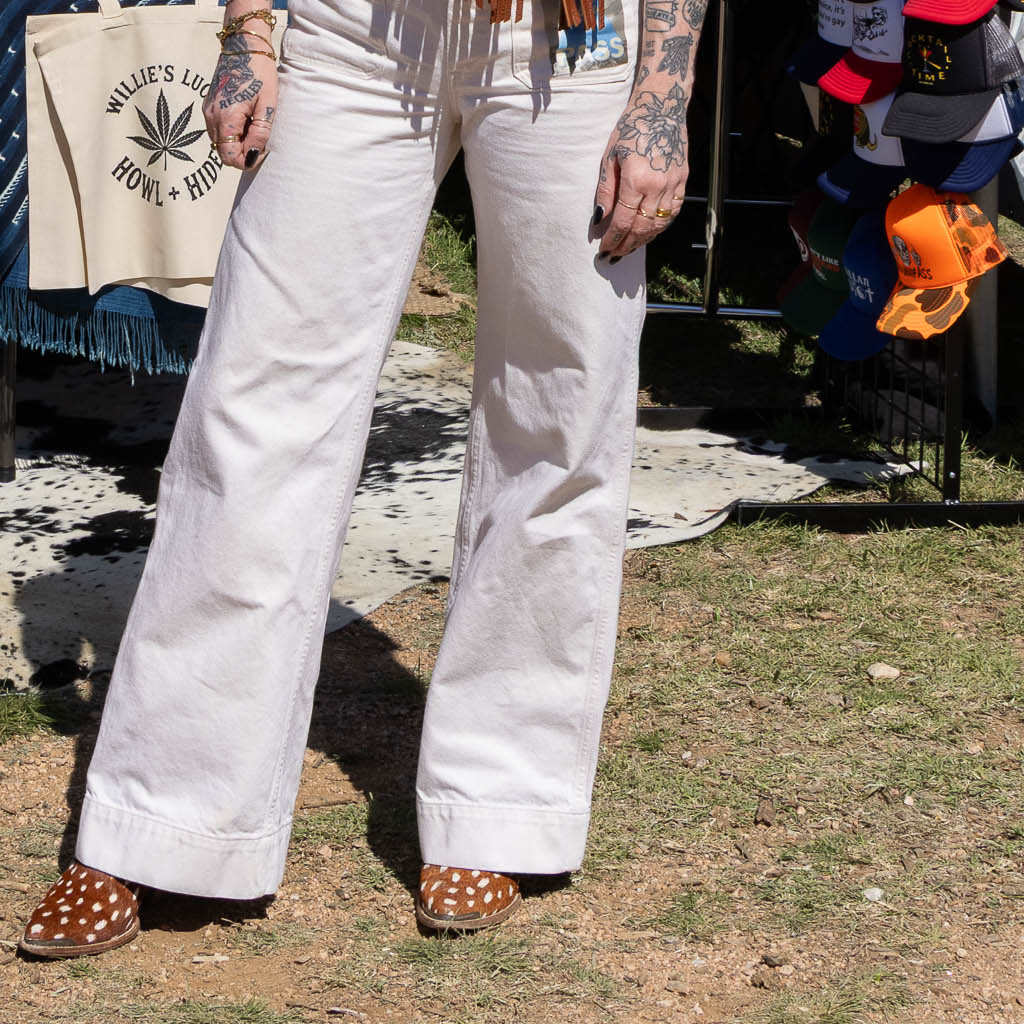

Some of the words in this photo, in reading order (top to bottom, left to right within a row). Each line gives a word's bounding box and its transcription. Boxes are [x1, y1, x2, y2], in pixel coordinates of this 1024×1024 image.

[105, 64, 174, 115] WILLIE'S
[181, 68, 211, 99] LUC
[911, 67, 945, 81] TIME
[111, 155, 164, 207] HOWL
[168, 186, 180, 200] +
[183, 149, 224, 201] HIDE
